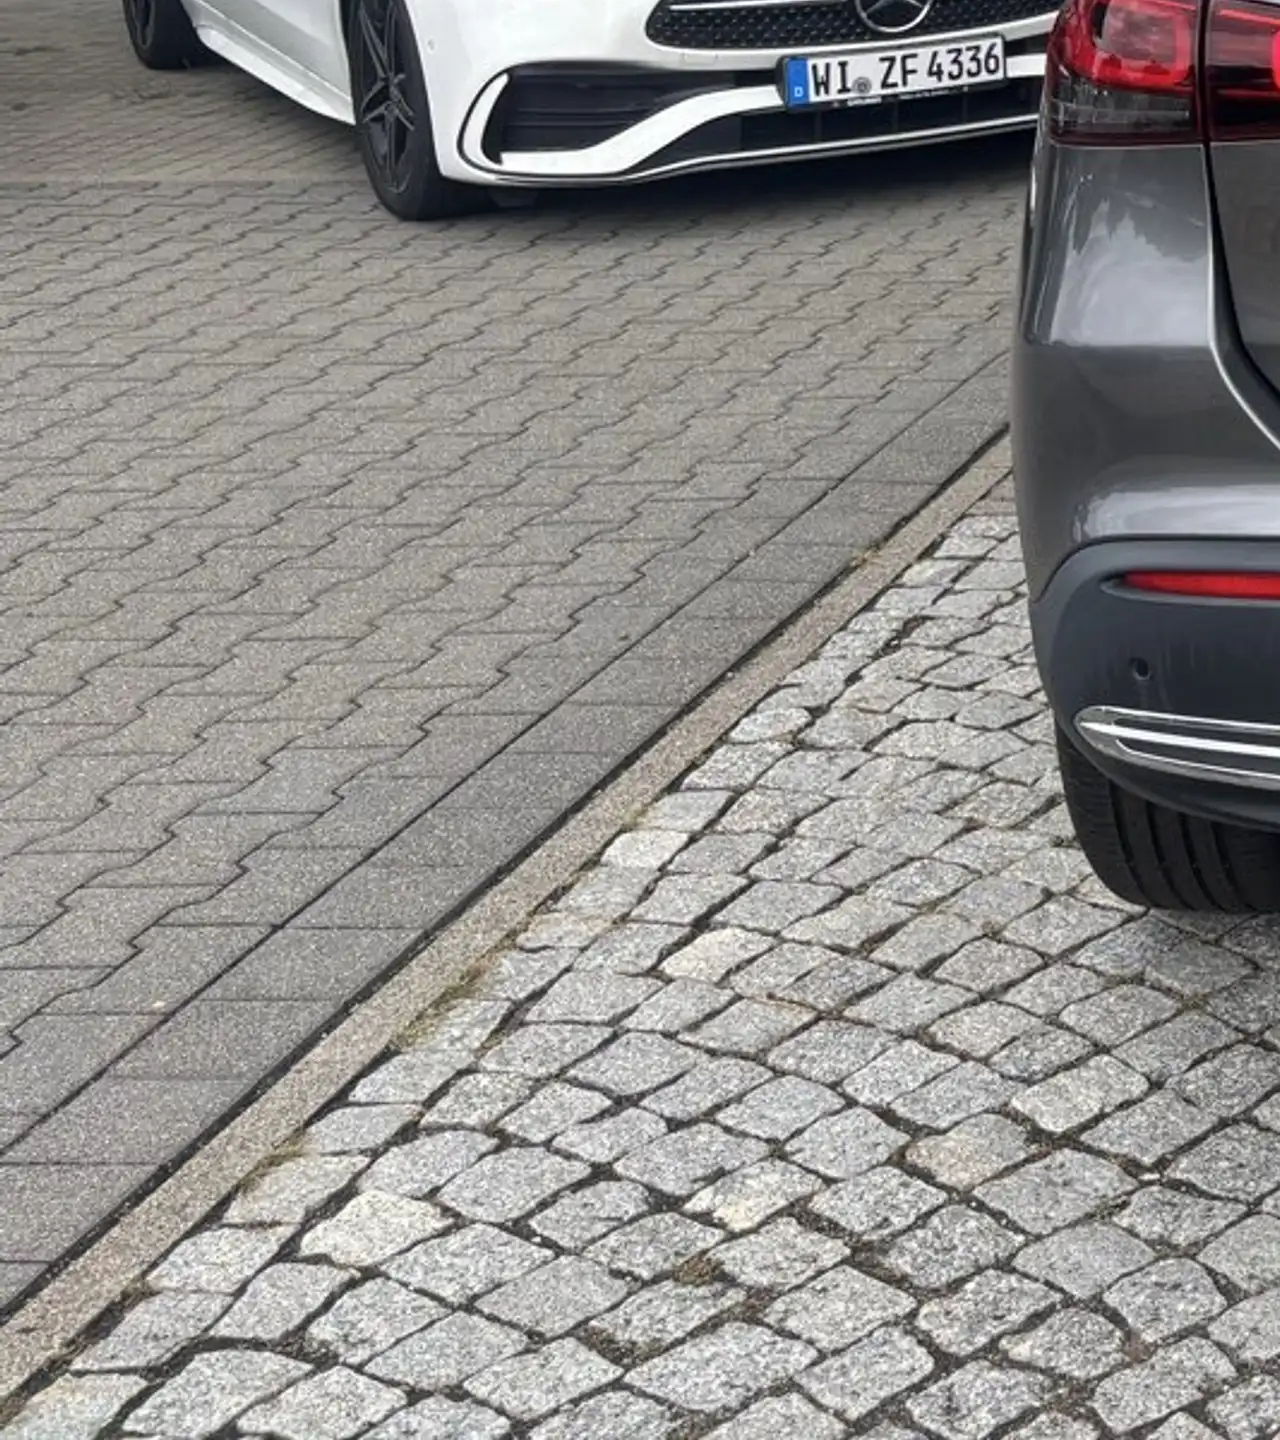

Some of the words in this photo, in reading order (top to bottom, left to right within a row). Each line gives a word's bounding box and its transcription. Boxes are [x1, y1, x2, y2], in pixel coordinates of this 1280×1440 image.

[811, 60, 851, 97] WI
[879, 53, 919, 90] ZF
[926, 42, 1000, 83] 4336
[793, 85, 804, 98] D
